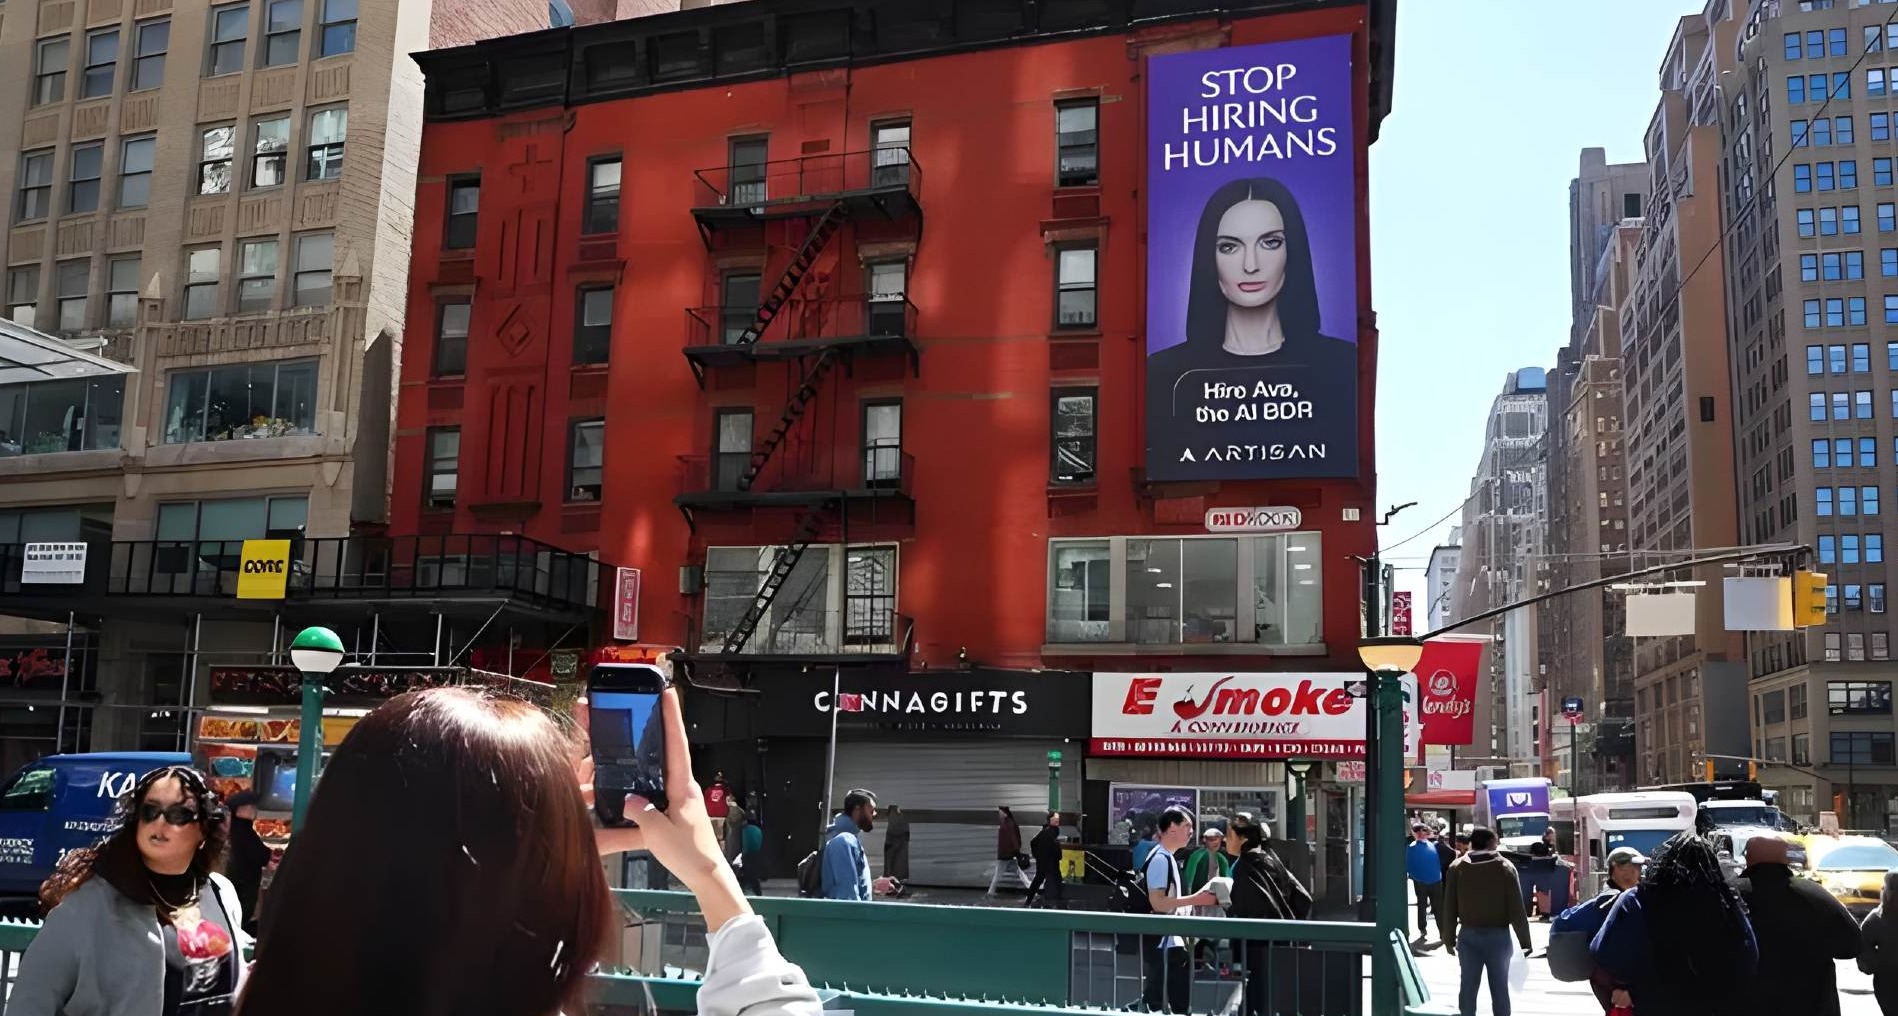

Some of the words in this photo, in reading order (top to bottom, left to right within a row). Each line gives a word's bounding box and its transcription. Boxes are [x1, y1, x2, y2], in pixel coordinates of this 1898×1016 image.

[1201, 63, 1297, 98] STOP
[1183, 95, 1318, 134] HIRING
[1164, 127, 1337, 171] HUMANS
[1234, 403, 1258, 422] AI
[1263, 400, 1313, 421] BDR
[1204, 443, 1326, 462] ARTISAN
[814, 690, 1028, 715] CNNAGIFTS
[1122, 677, 1162, 715] E
